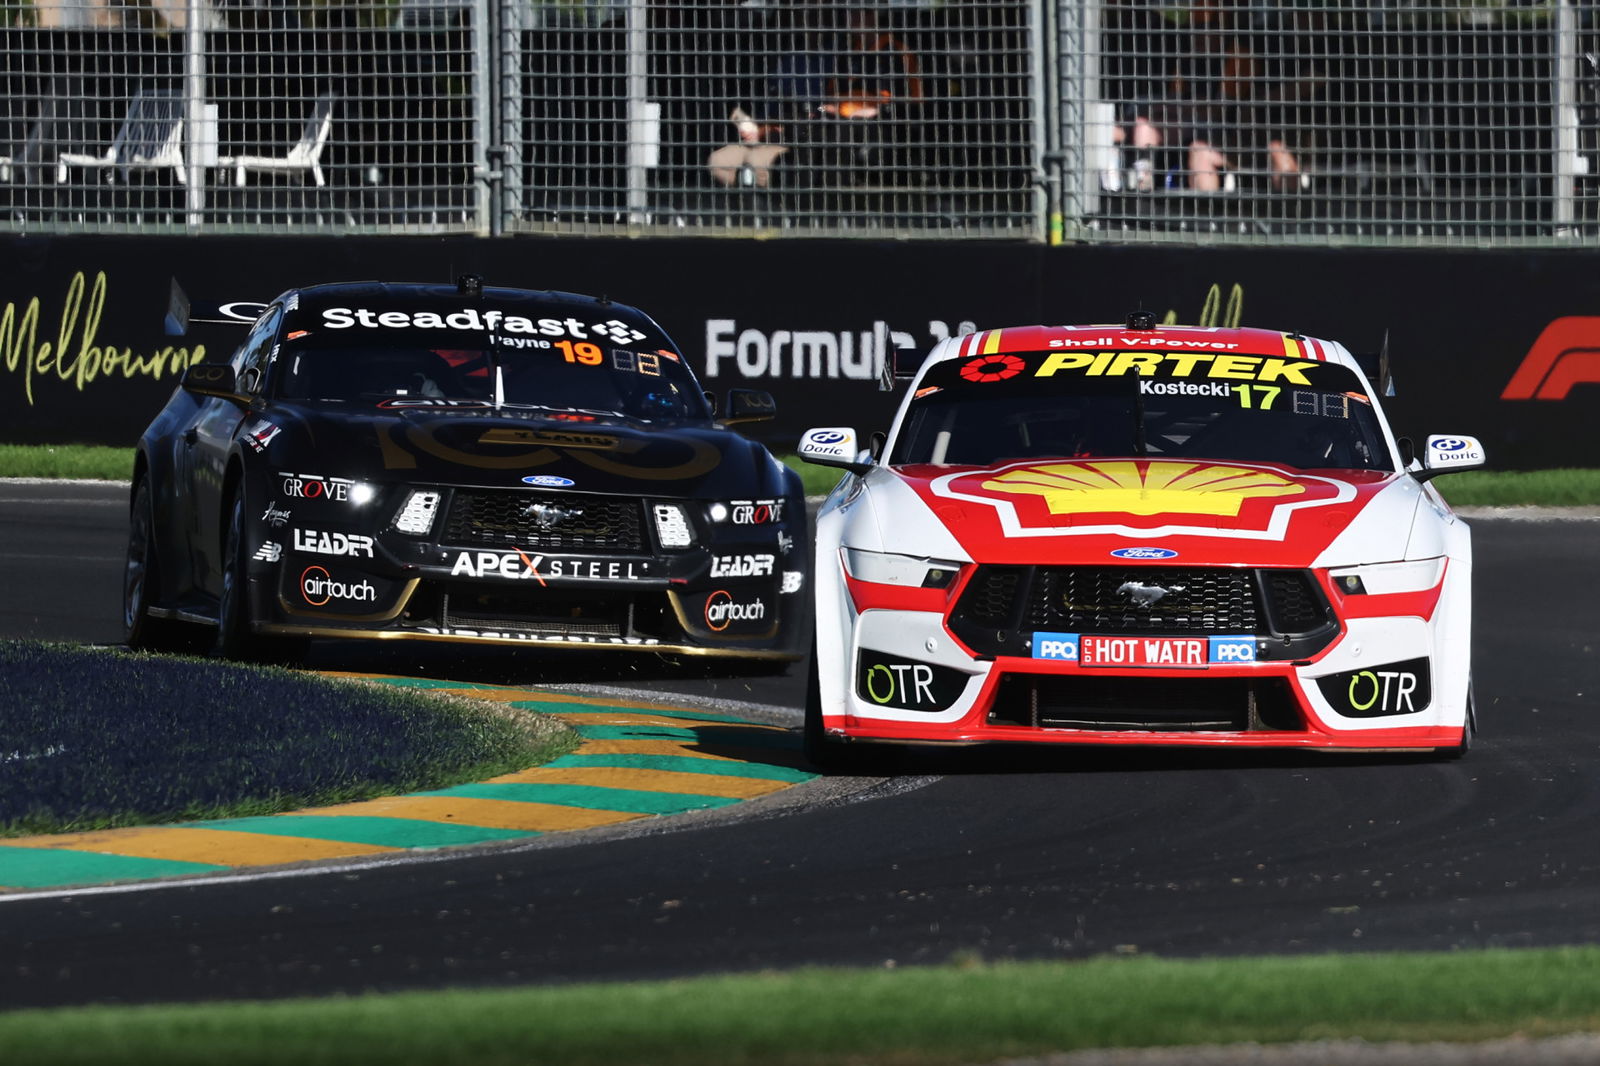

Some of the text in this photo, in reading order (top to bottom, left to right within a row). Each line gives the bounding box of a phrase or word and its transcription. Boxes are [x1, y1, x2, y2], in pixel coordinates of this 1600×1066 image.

[322, 307, 588, 339] Steadfast
[554, 340, 603, 366] 19
[1049, 337, 1239, 349] Shell V-Power
[1034, 352, 1321, 386] PIRTEK
[1140, 380, 1231, 398] Kostecki
[1231, 385, 1281, 410] 17
[803, 444, 844, 455] Doric
[1439, 451, 1479, 461] Doric
[283, 478, 349, 502] GROVE
[293, 528, 374, 558] LEADER
[451, 549, 638, 583] APEX STEEL
[710, 554, 775, 578] LEADER
[304, 577, 377, 602] airtouch
[708, 597, 765, 621] airtouch
[1040, 640, 1078, 659] PPQ
[1095, 639, 1202, 664] HOT WATR
[1217, 643, 1254, 661] PPQ
[868, 663, 936, 704] OTR
[1348, 670, 1417, 711] OTR
